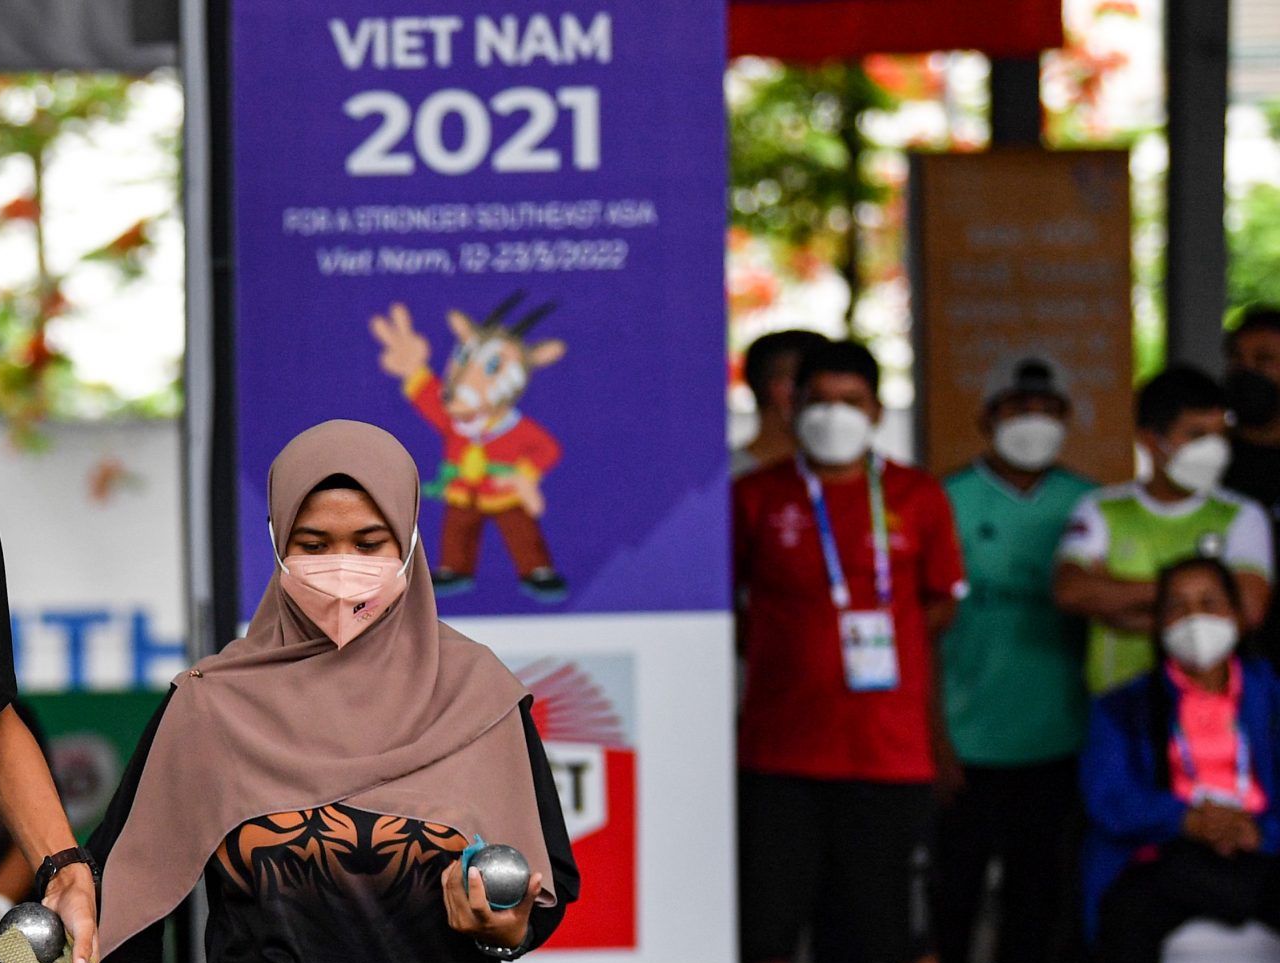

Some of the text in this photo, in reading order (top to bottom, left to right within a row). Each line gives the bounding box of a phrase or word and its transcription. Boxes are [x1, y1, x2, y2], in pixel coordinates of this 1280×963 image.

[328, 12, 612, 69] VIET NAM
[344, 86, 601, 176] 2021
[283, 199, 657, 234] FOR A STRONGER SOUTHEAST ASIA
[317, 247, 373, 275] Viet
[377, 245, 455, 276] Nam,
